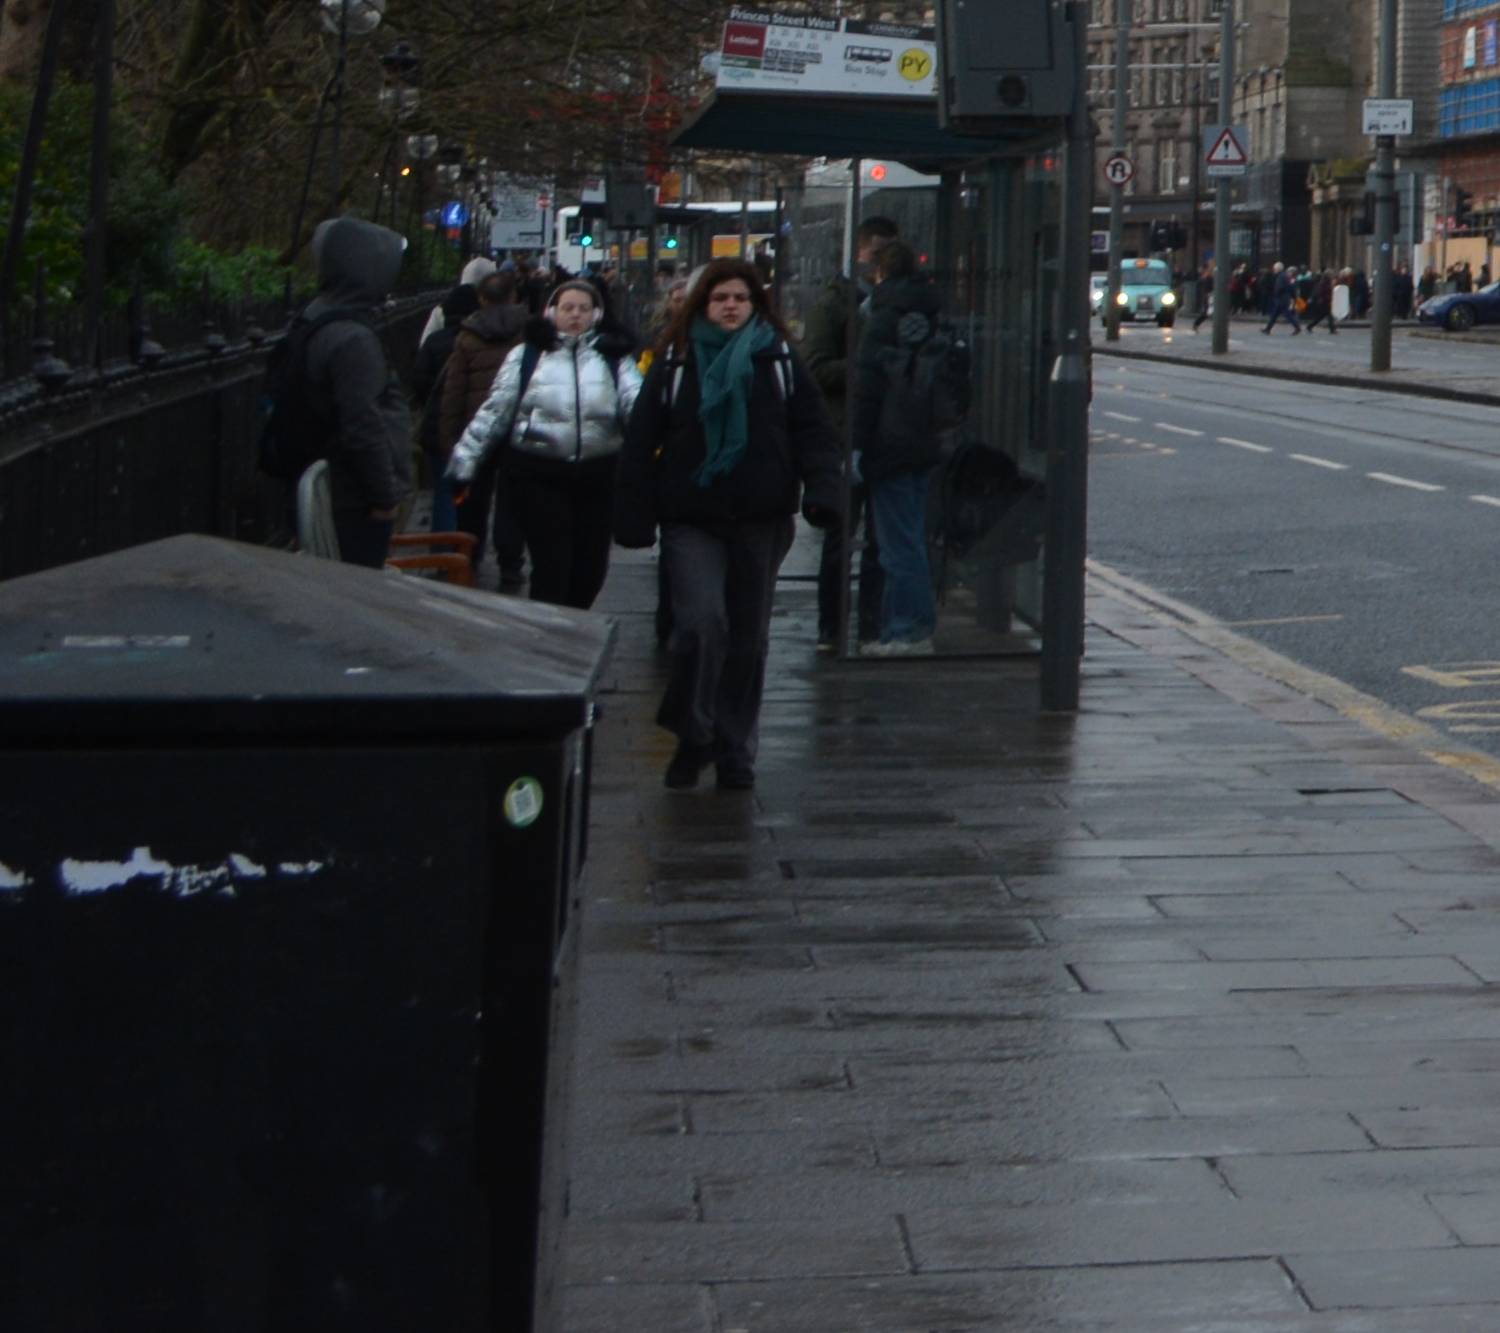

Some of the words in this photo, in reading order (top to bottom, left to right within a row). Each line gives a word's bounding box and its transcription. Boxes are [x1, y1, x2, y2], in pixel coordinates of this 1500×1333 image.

[730, 9, 770, 23] Princes
[772, 13, 806, 25] Street
[807, 17, 837, 29] West
[901, 55, 927, 72] PY
